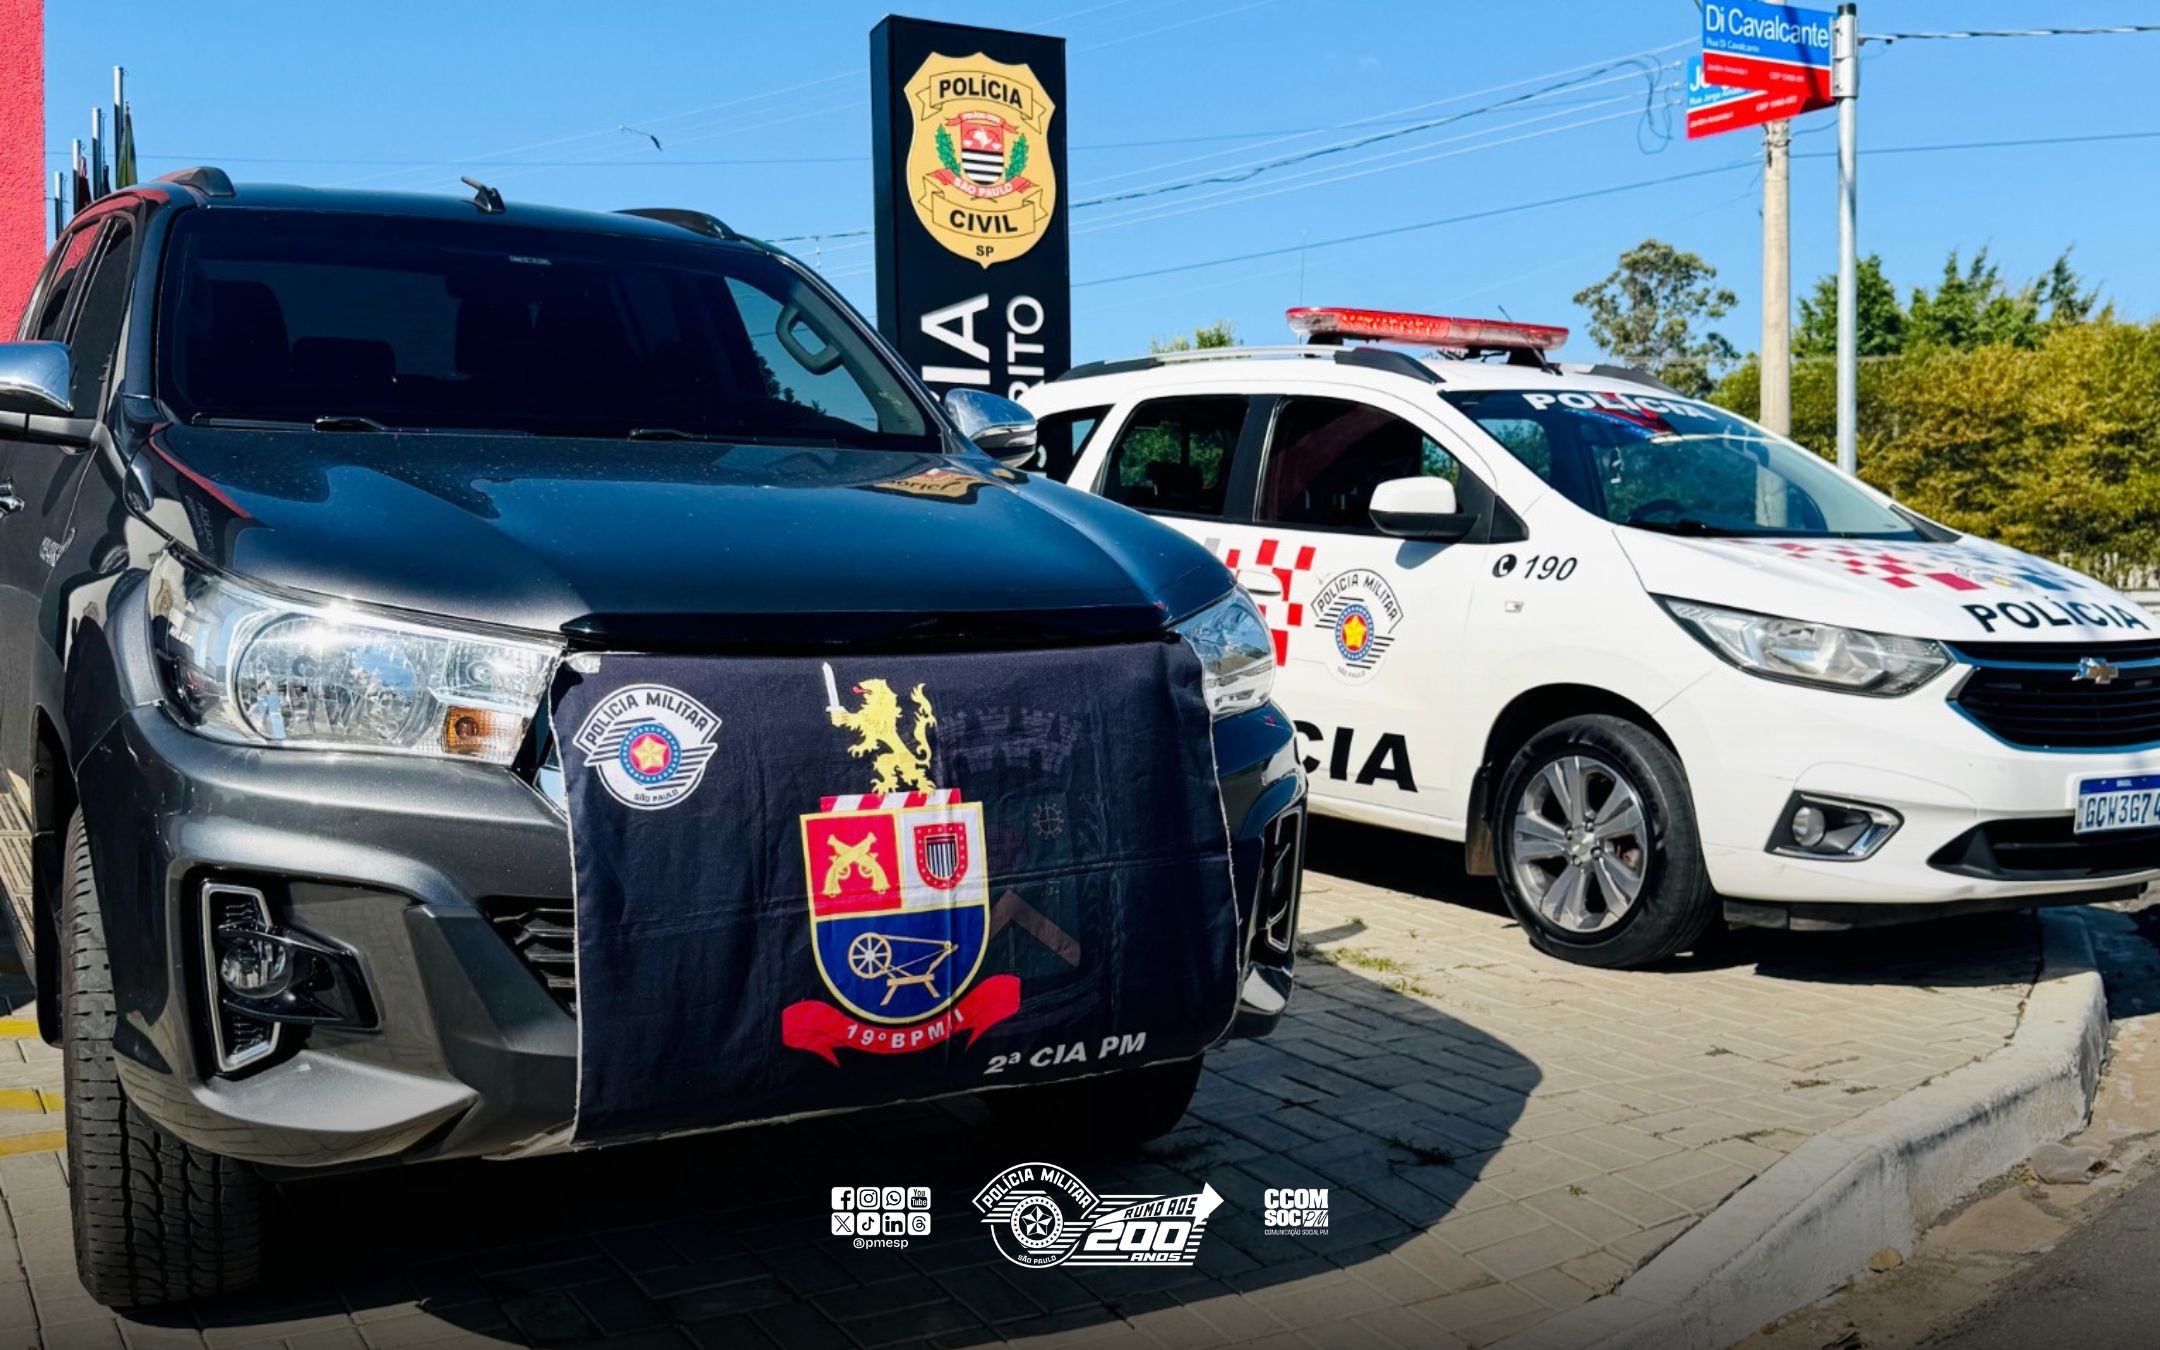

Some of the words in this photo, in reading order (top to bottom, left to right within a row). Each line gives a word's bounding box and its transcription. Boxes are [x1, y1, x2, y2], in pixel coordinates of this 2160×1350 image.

[1706, 4, 1724, 33] Di
[1728, 8, 1829, 48] Cavalcante
[939, 74, 1023, 109] POLÍCIA
[978, 183, 1013, 198] PAULO
[949, 209, 1018, 233] CIVIL
[975, 245, 994, 257] SP
[921, 293, 991, 401] IA
[1524, 554, 1578, 581] 190
[1363, 575, 1398, 622] MILITAR
[1960, 595, 2151, 633] POLÍCIA
[646, 691, 709, 732] MILITAR
[1029, 1041, 1087, 1067] CIA
[1098, 1032, 1147, 1060] PM
